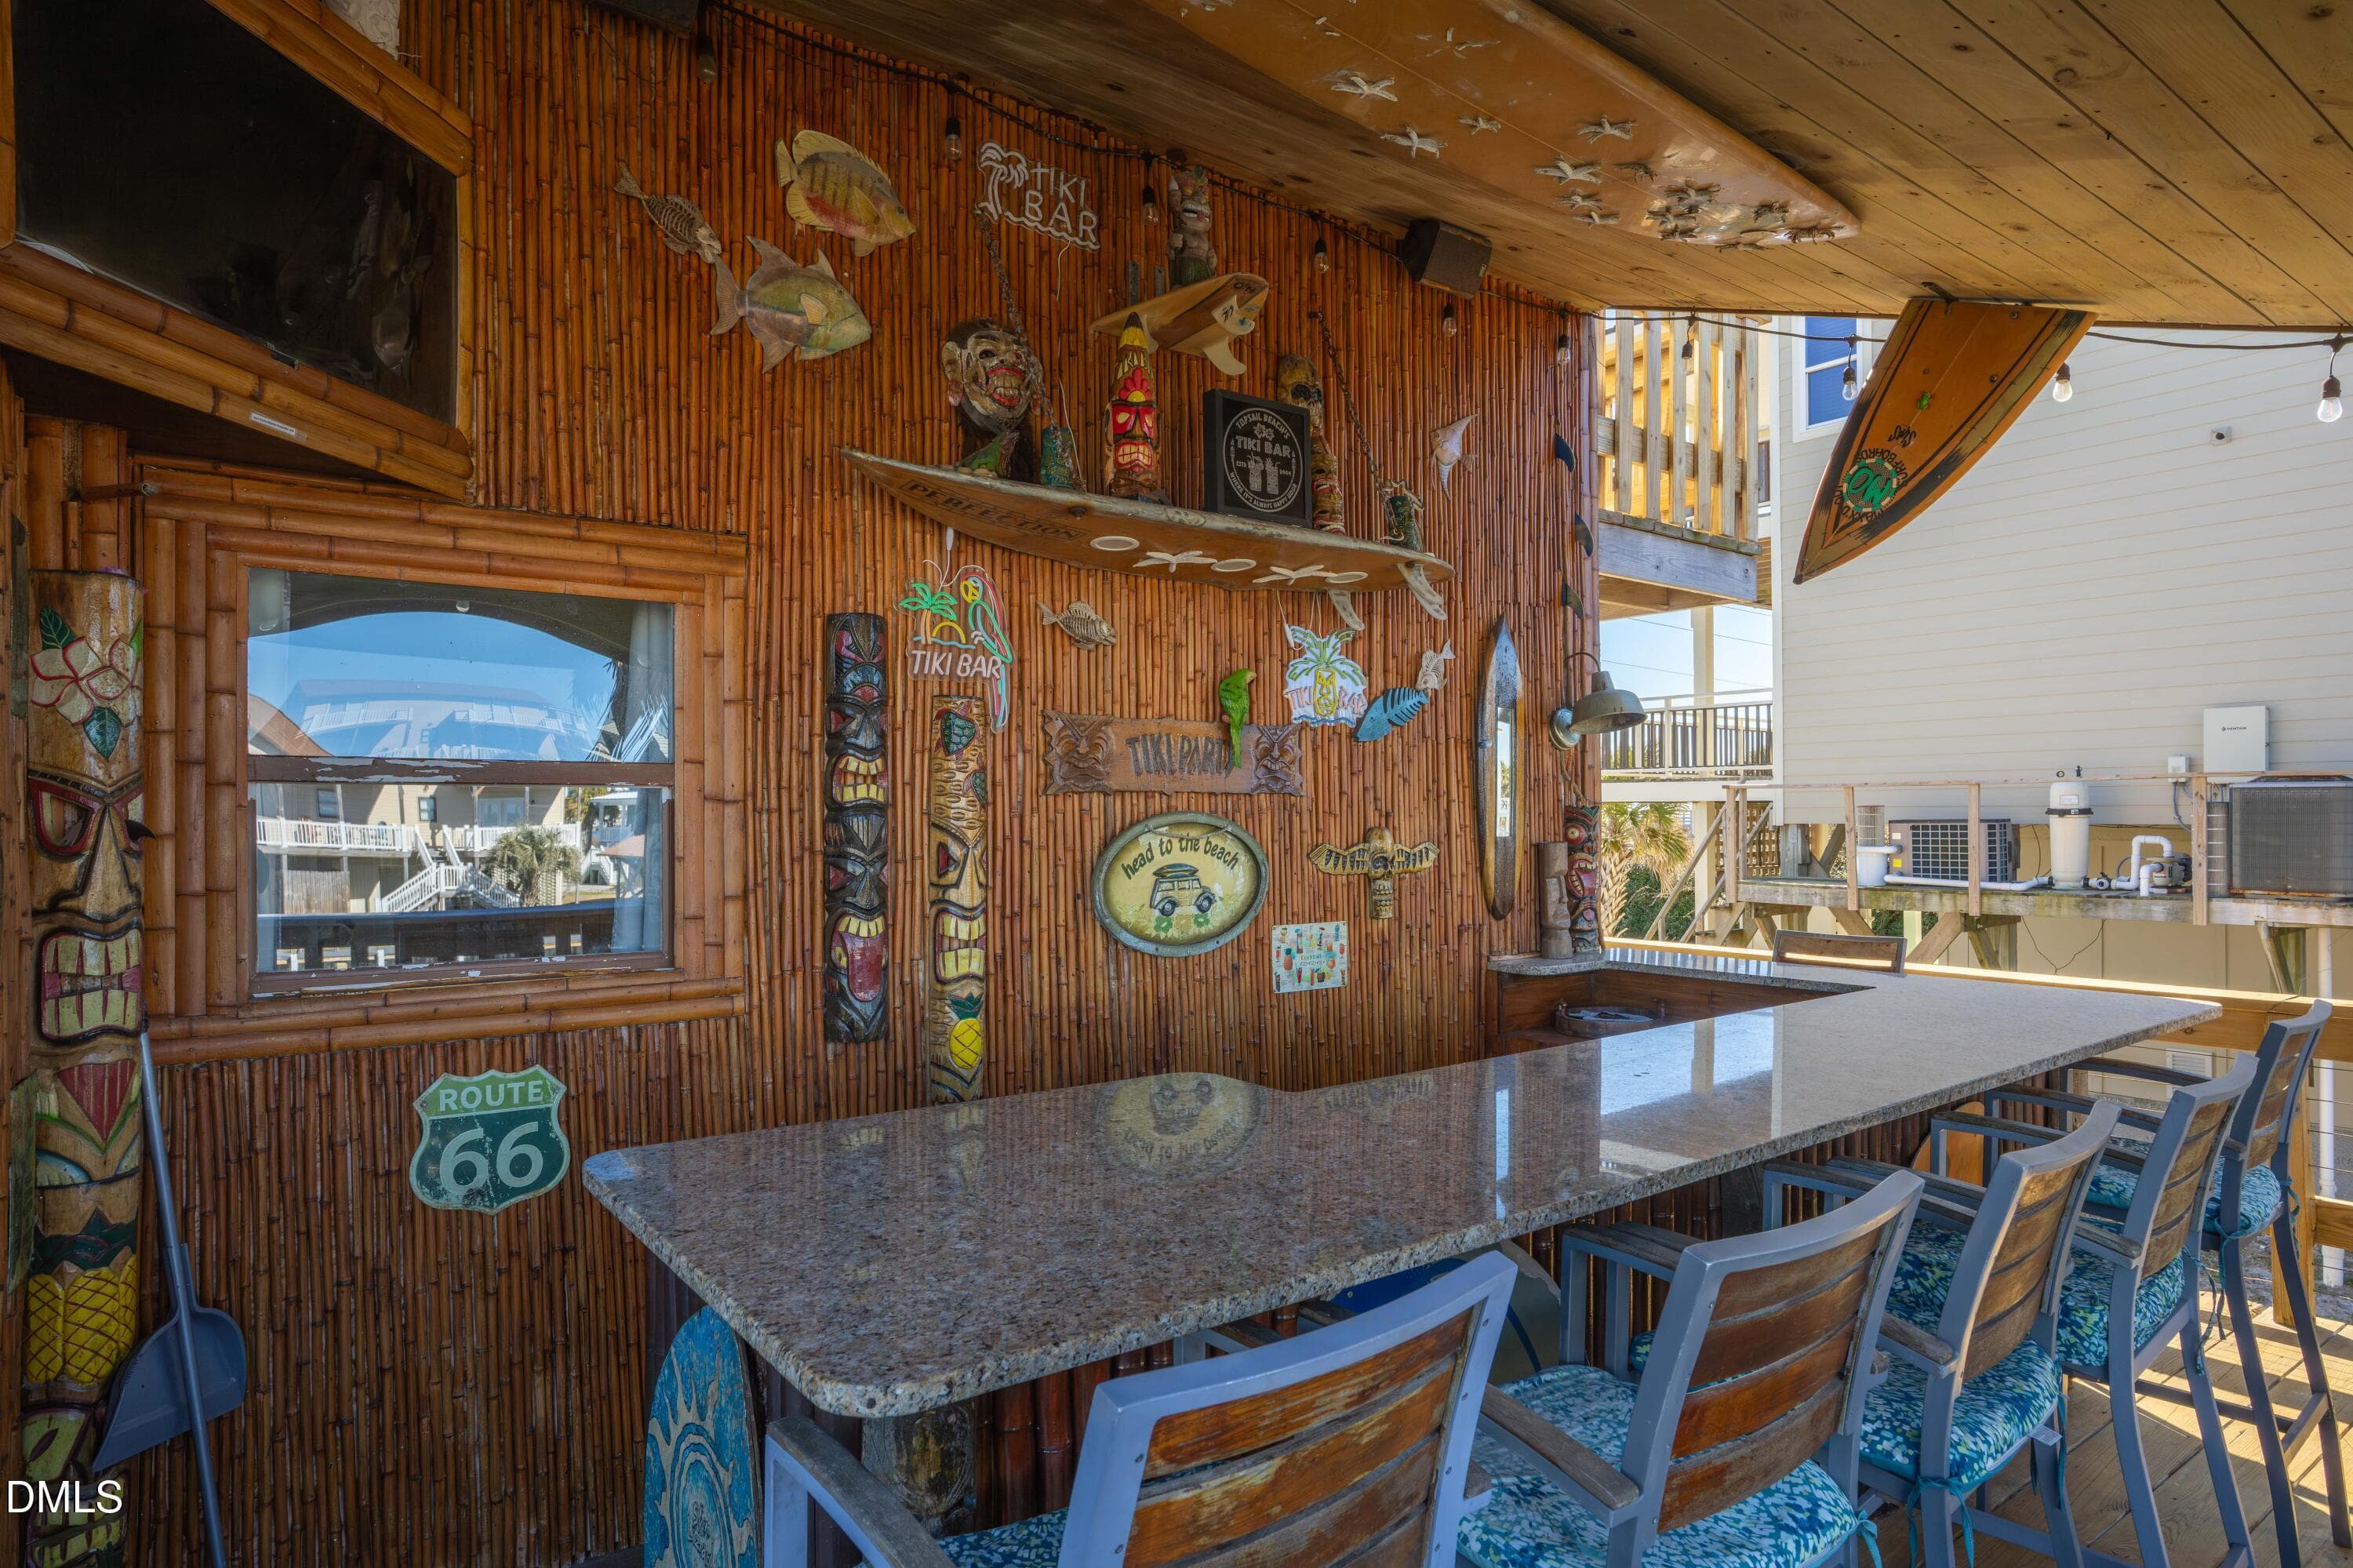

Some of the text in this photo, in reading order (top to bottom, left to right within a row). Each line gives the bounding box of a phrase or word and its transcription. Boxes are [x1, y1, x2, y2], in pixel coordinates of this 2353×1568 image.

[1030, 162, 1086, 207] TIKI
[1025, 190, 1098, 242] BAR
[1235, 413, 1291, 439] TOPSAIL BEACH'S
[1236, 435, 1292, 458] TIKI BAR
[1230, 471, 1244, 493] WHERE
[1253, 499, 1273, 509] ALWAYS
[1273, 496, 1288, 508] HAPPY
[1287, 483, 1298, 499] HOUR
[908, 482, 1080, 540] PERFECTION
[911, 650, 1002, 679] TIKI BAR
[1337, 686, 1366, 716] BAR
[1125, 733, 1174, 776] TIKI
[1121, 833, 1239, 880] head to the beach
[438, 1079, 544, 1111] ROUTE
[438, 1121, 544, 1195] 66
